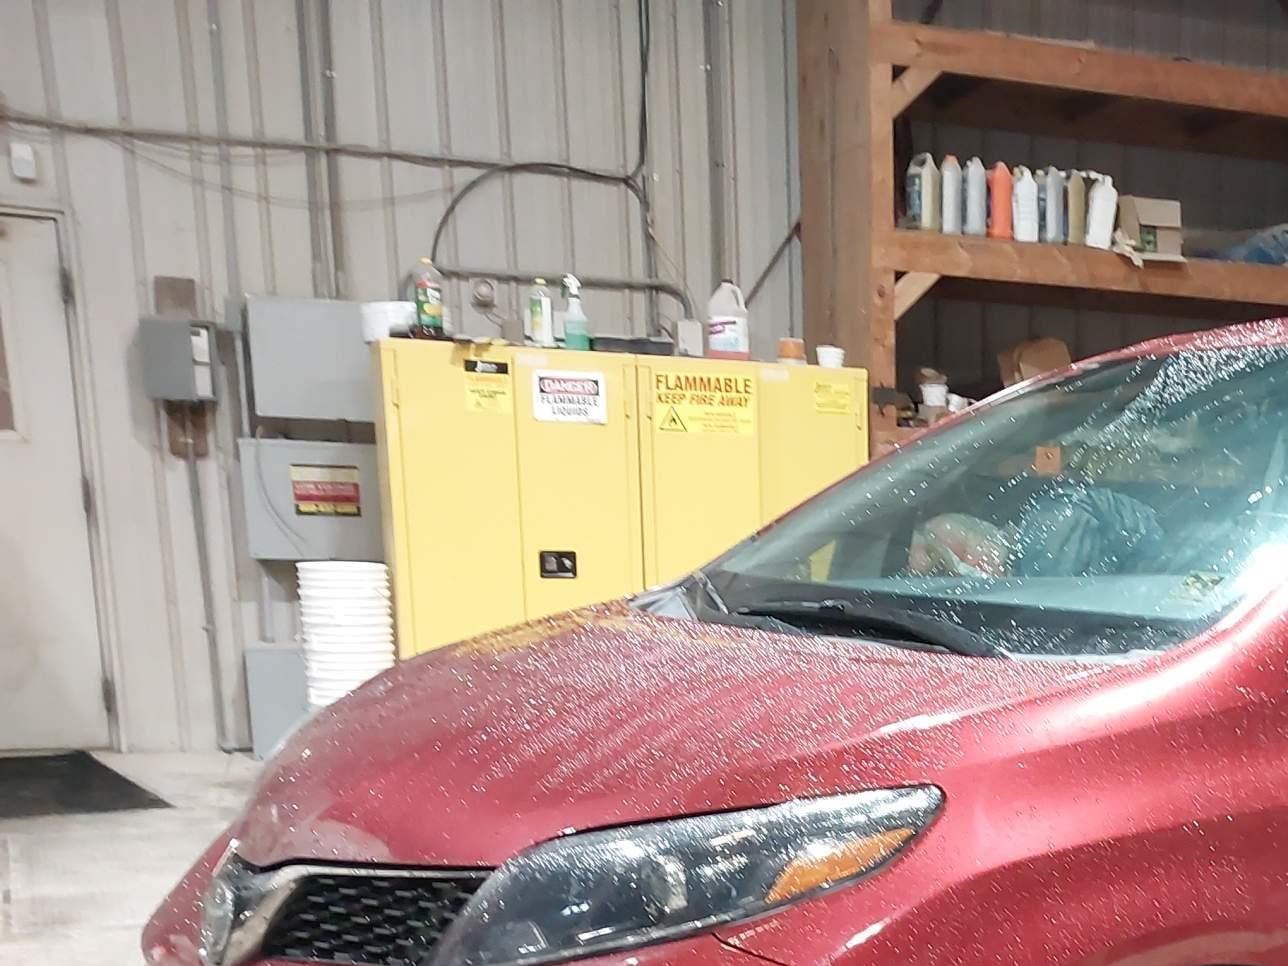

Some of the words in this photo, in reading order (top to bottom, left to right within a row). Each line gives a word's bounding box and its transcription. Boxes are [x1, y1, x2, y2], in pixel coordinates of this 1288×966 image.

[541, 379, 598, 394] DANGER
[656, 374, 752, 394] FLAMMABLE
[540, 394, 599, 407] FLAMMABLE
[656, 392, 686, 405] KEEP
[690, 394, 715, 407] FIRE
[718, 395, 750, 408] AWAY
[552, 405, 589, 417] LIQUIDS
